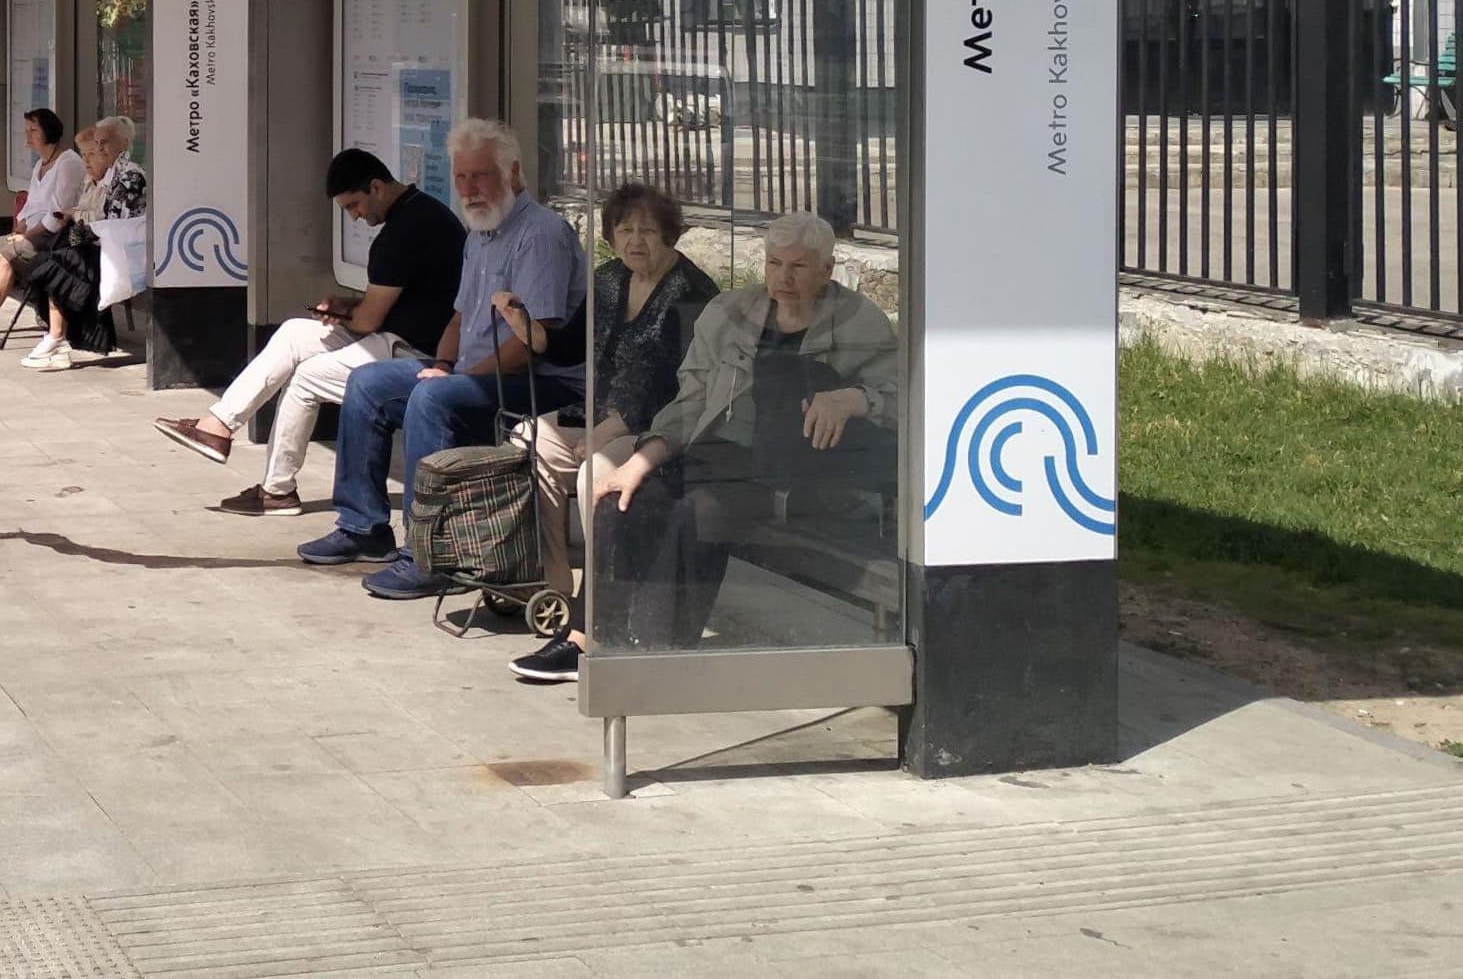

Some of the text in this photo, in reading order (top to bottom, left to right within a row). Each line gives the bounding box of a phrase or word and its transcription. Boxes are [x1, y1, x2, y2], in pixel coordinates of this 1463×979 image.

[185, 0, 200, 98] «Каховская»
[205, 52, 217, 86] Metro
[185, 100, 203, 154] Метро
[1047, 93, 1070, 176] Metro
